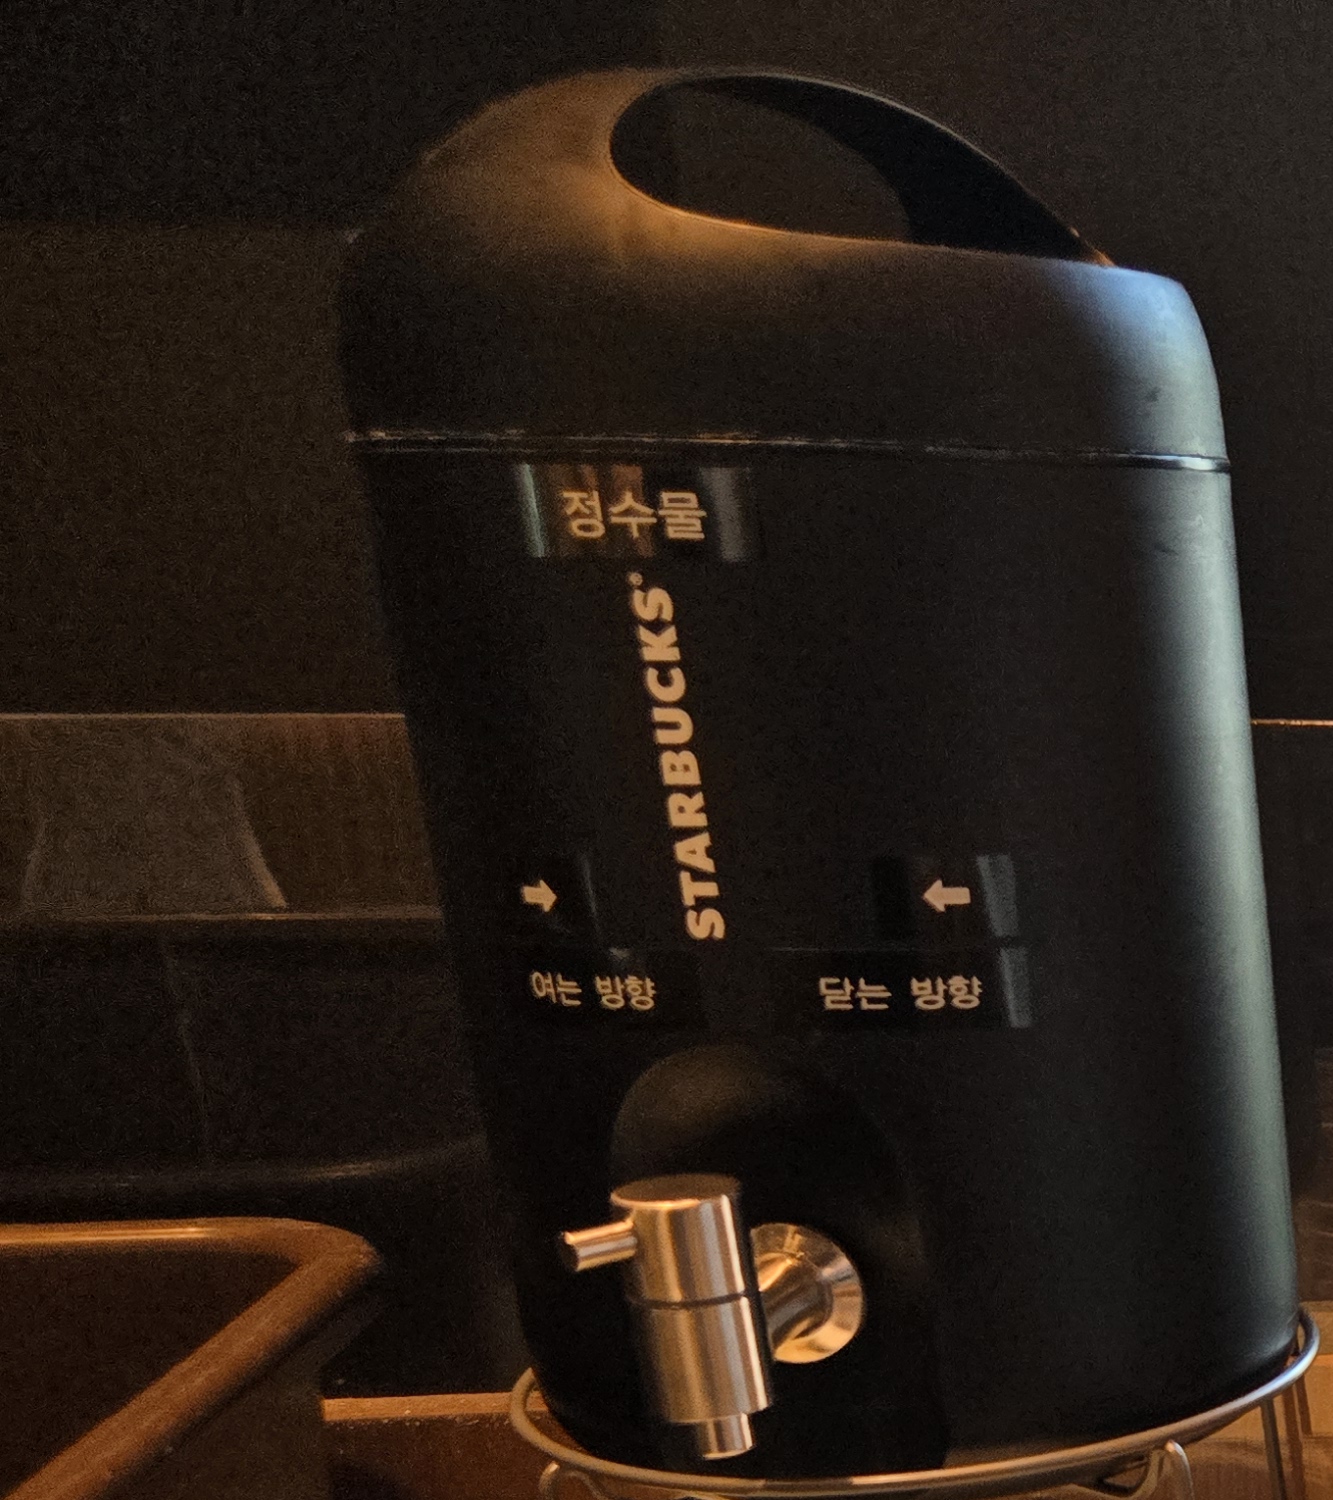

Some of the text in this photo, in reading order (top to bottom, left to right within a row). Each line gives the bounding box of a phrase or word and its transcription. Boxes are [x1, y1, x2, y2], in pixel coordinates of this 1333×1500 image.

[561, 490, 707, 540] 정수물
[530, 971, 657, 1011] 여는 방향
[819, 974, 983, 1011] 닫는 방향
